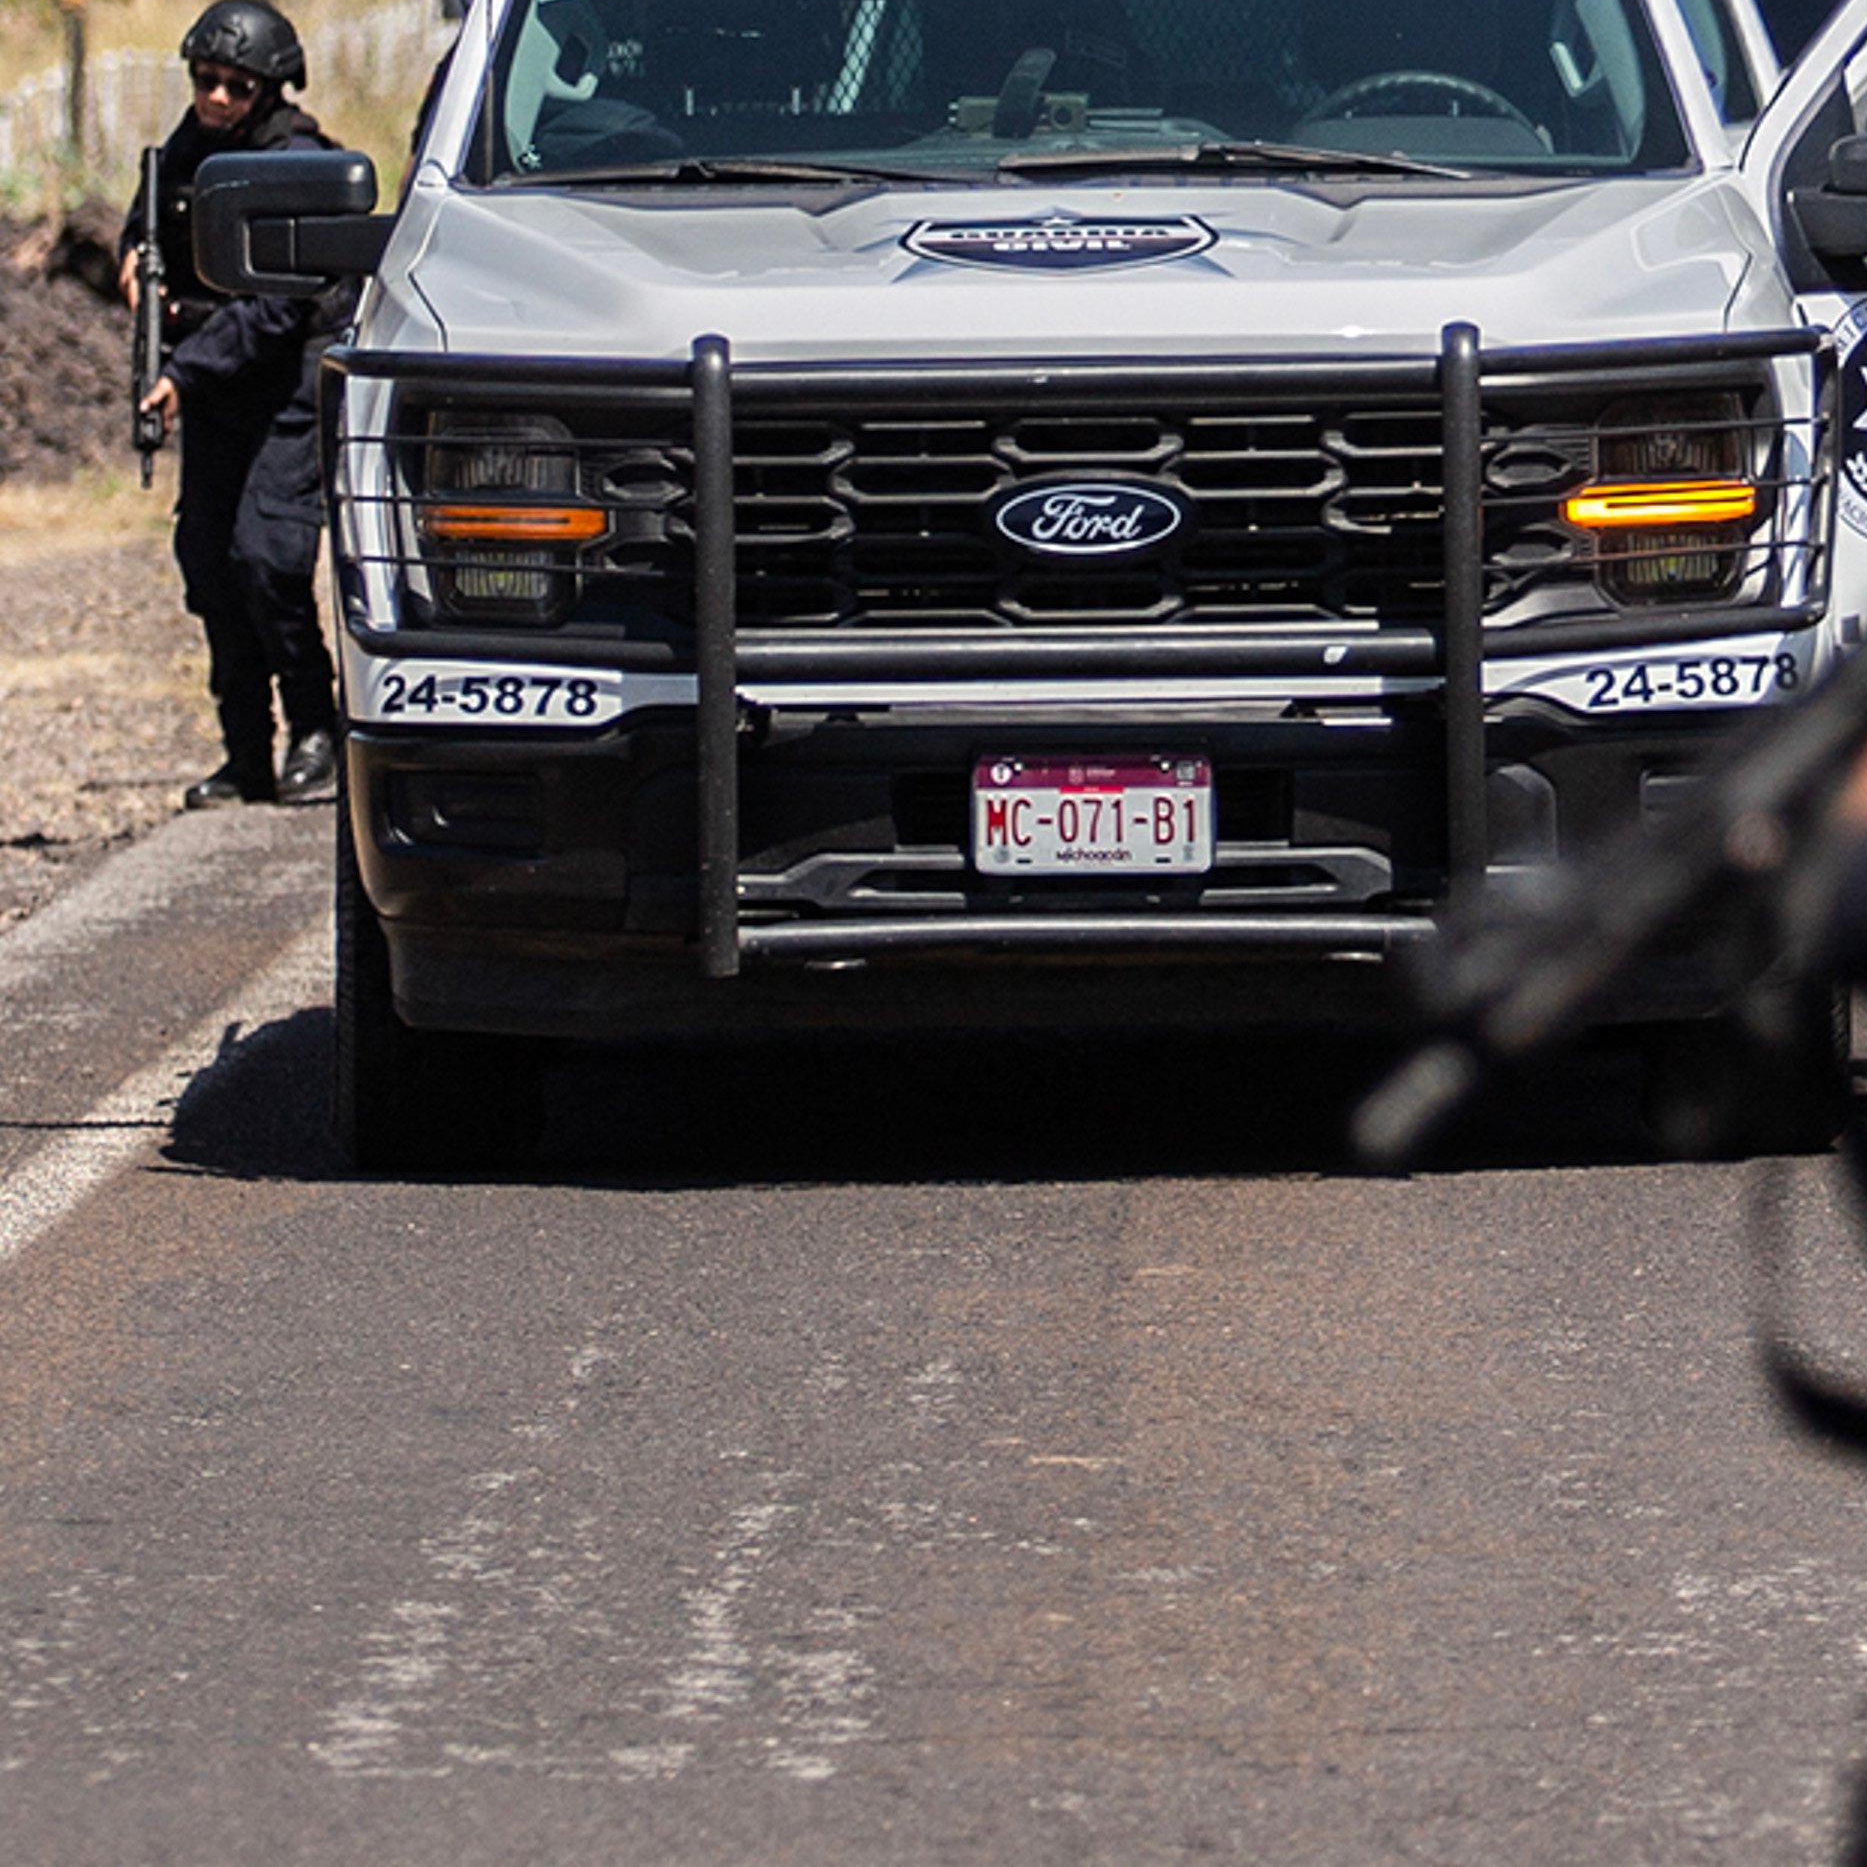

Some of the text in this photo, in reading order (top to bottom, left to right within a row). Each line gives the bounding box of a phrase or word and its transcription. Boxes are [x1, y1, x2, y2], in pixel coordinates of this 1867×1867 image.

[1032, 494, 1146, 540] Ford
[381, 673, 599, 717] 24-5878
[1585, 652, 1799, 708] 24-5878
[986, 797, 1196, 845] MC-071-B1
